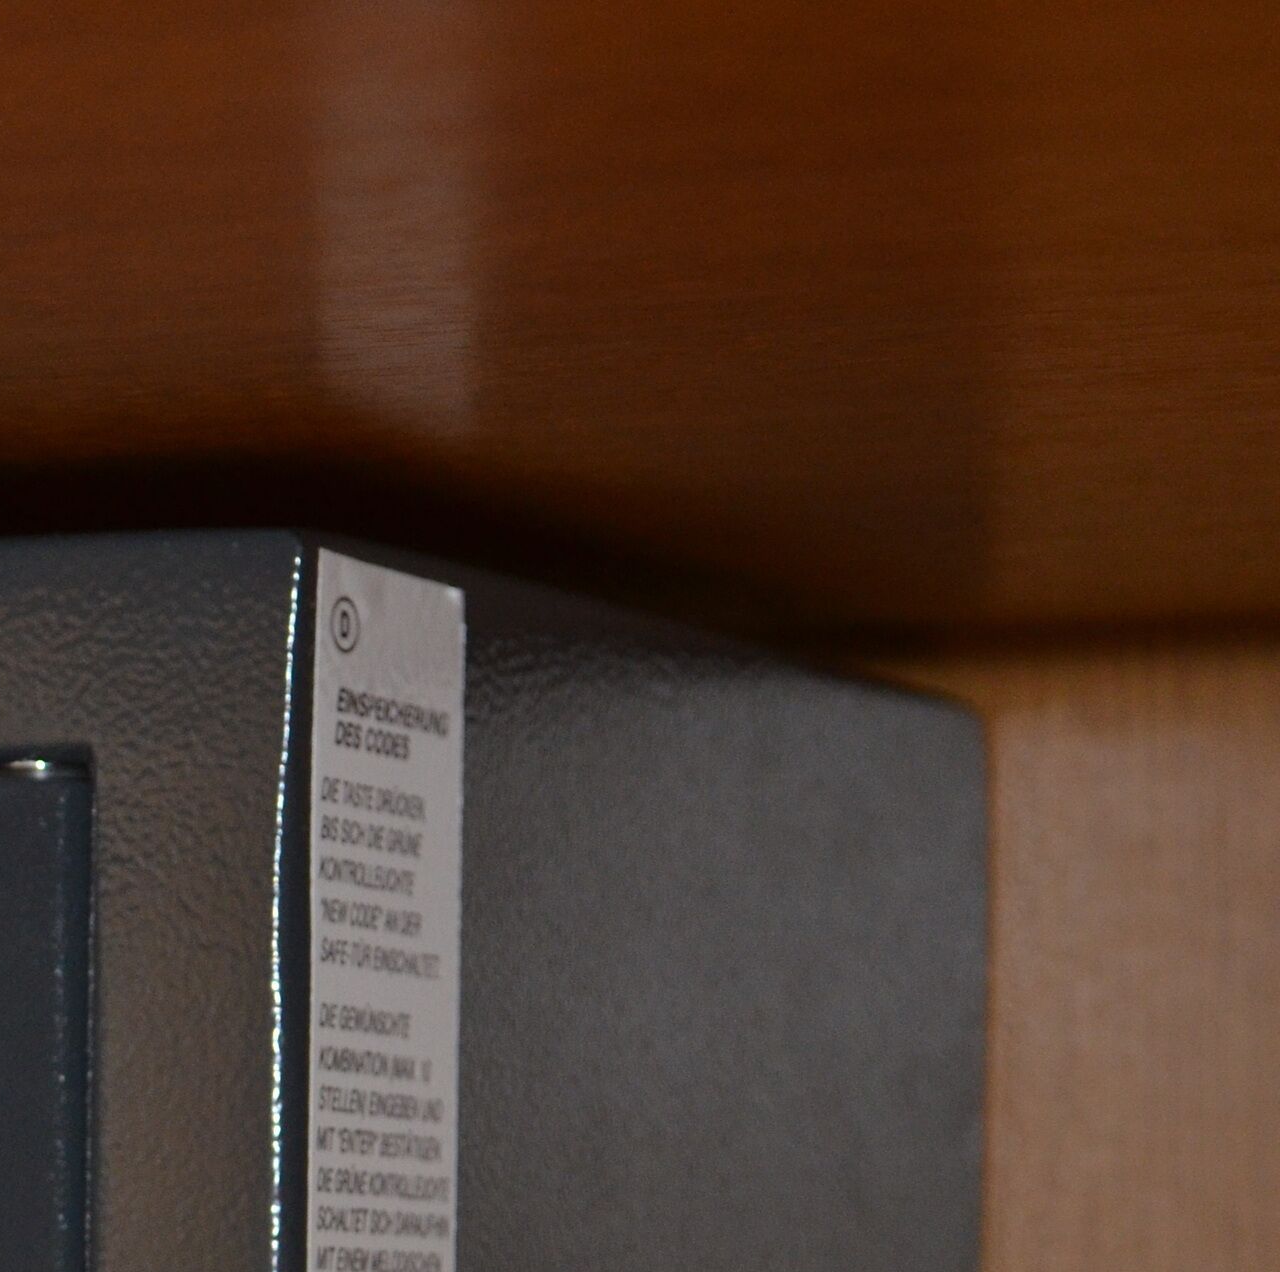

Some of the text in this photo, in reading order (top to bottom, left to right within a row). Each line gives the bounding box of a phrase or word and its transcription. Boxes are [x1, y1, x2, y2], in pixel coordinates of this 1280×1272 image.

[337, 687, 450, 736] EINSPEICHERUNG
[335, 721, 410, 760] DES CODES
[322, 777, 340, 803] DIE
[321, 815, 339, 841] BIS
[341, 819, 365, 844] SICH
[367, 824, 384, 849] DIE
[320, 1003, 336, 1028] DIE
[320, 1046, 387, 1076] KOMBINATION
[317, 1126, 334, 1151] MIT
[317, 1167, 333, 1192] DIE
[336, 1164, 367, 1193] GRÜNE
[317, 1206, 368, 1233] SCHALTET
[370, 1210, 391, 1234] SICH
[317, 1247, 334, 1271] MIT
